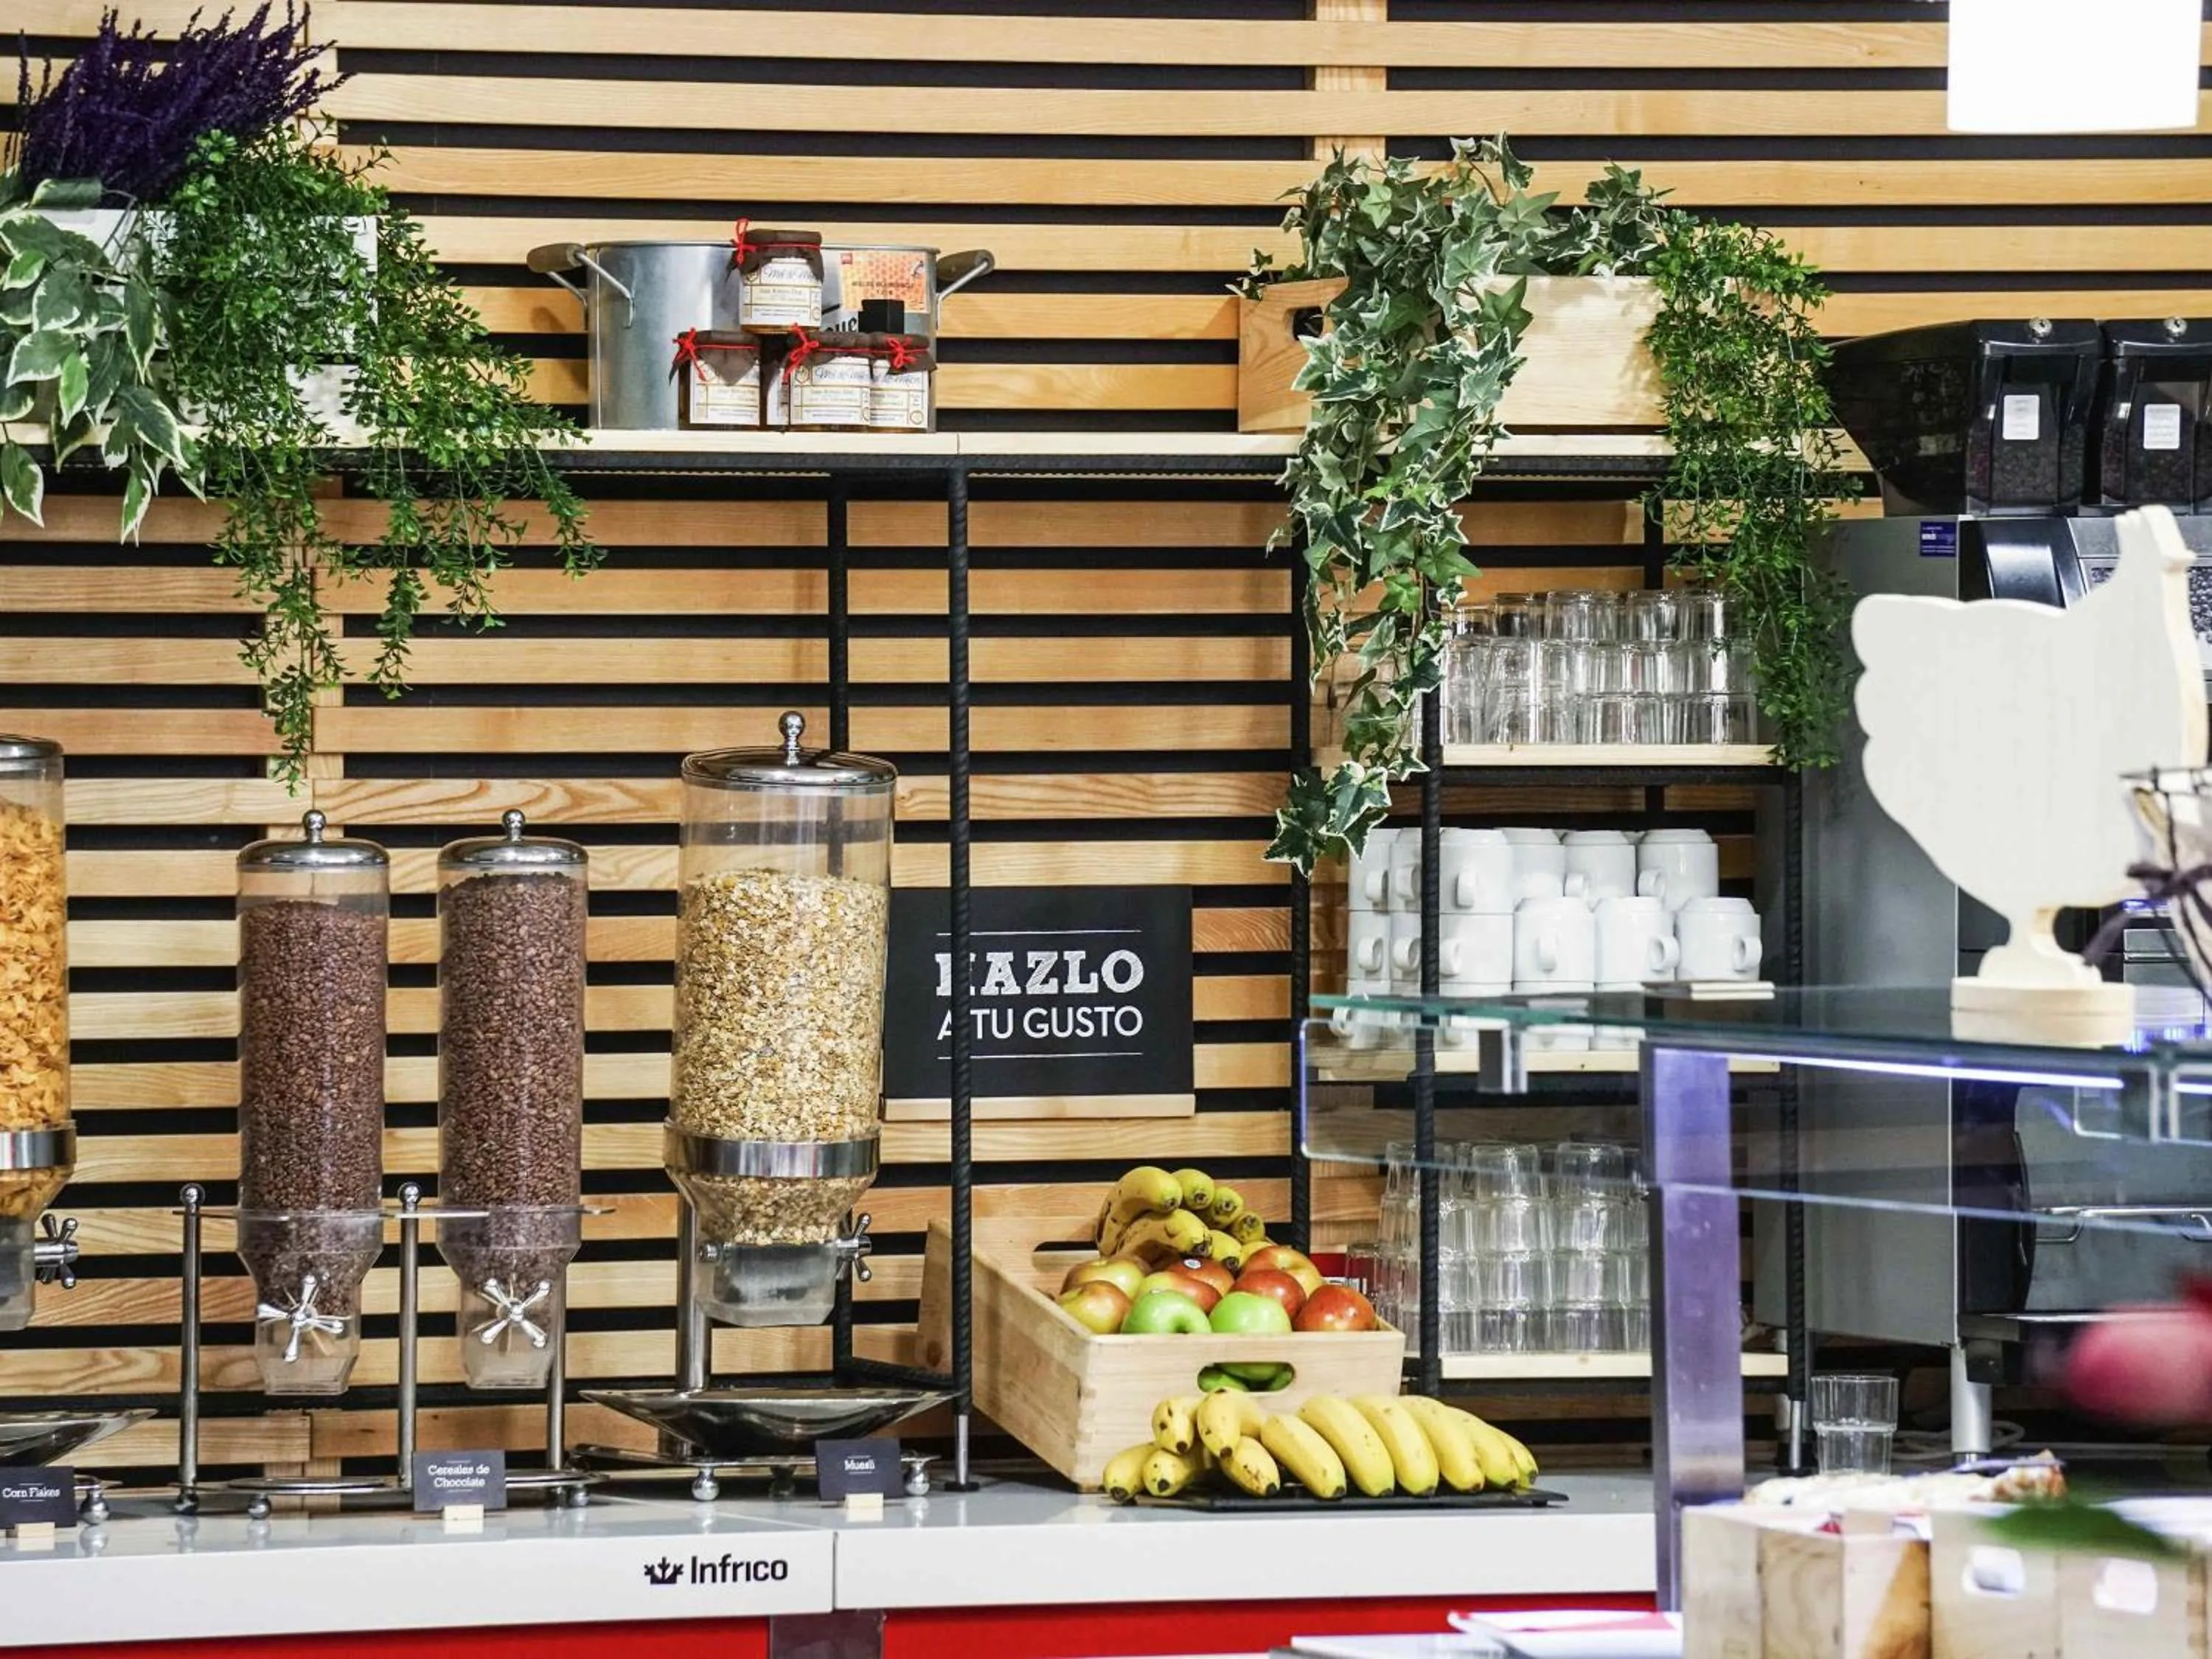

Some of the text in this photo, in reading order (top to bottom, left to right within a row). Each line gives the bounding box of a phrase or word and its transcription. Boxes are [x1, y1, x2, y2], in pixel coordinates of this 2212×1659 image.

[970, 1008, 1014, 1039] TU
[1023, 1005, 1144, 1039] GUSTO
[428, 1464, 490, 1475] Cereales de
[434, 1477, 486, 1487] Chocolate
[2, 1486, 60, 1498] Corn Flakes
[691, 1554, 788, 1584] Infrico
